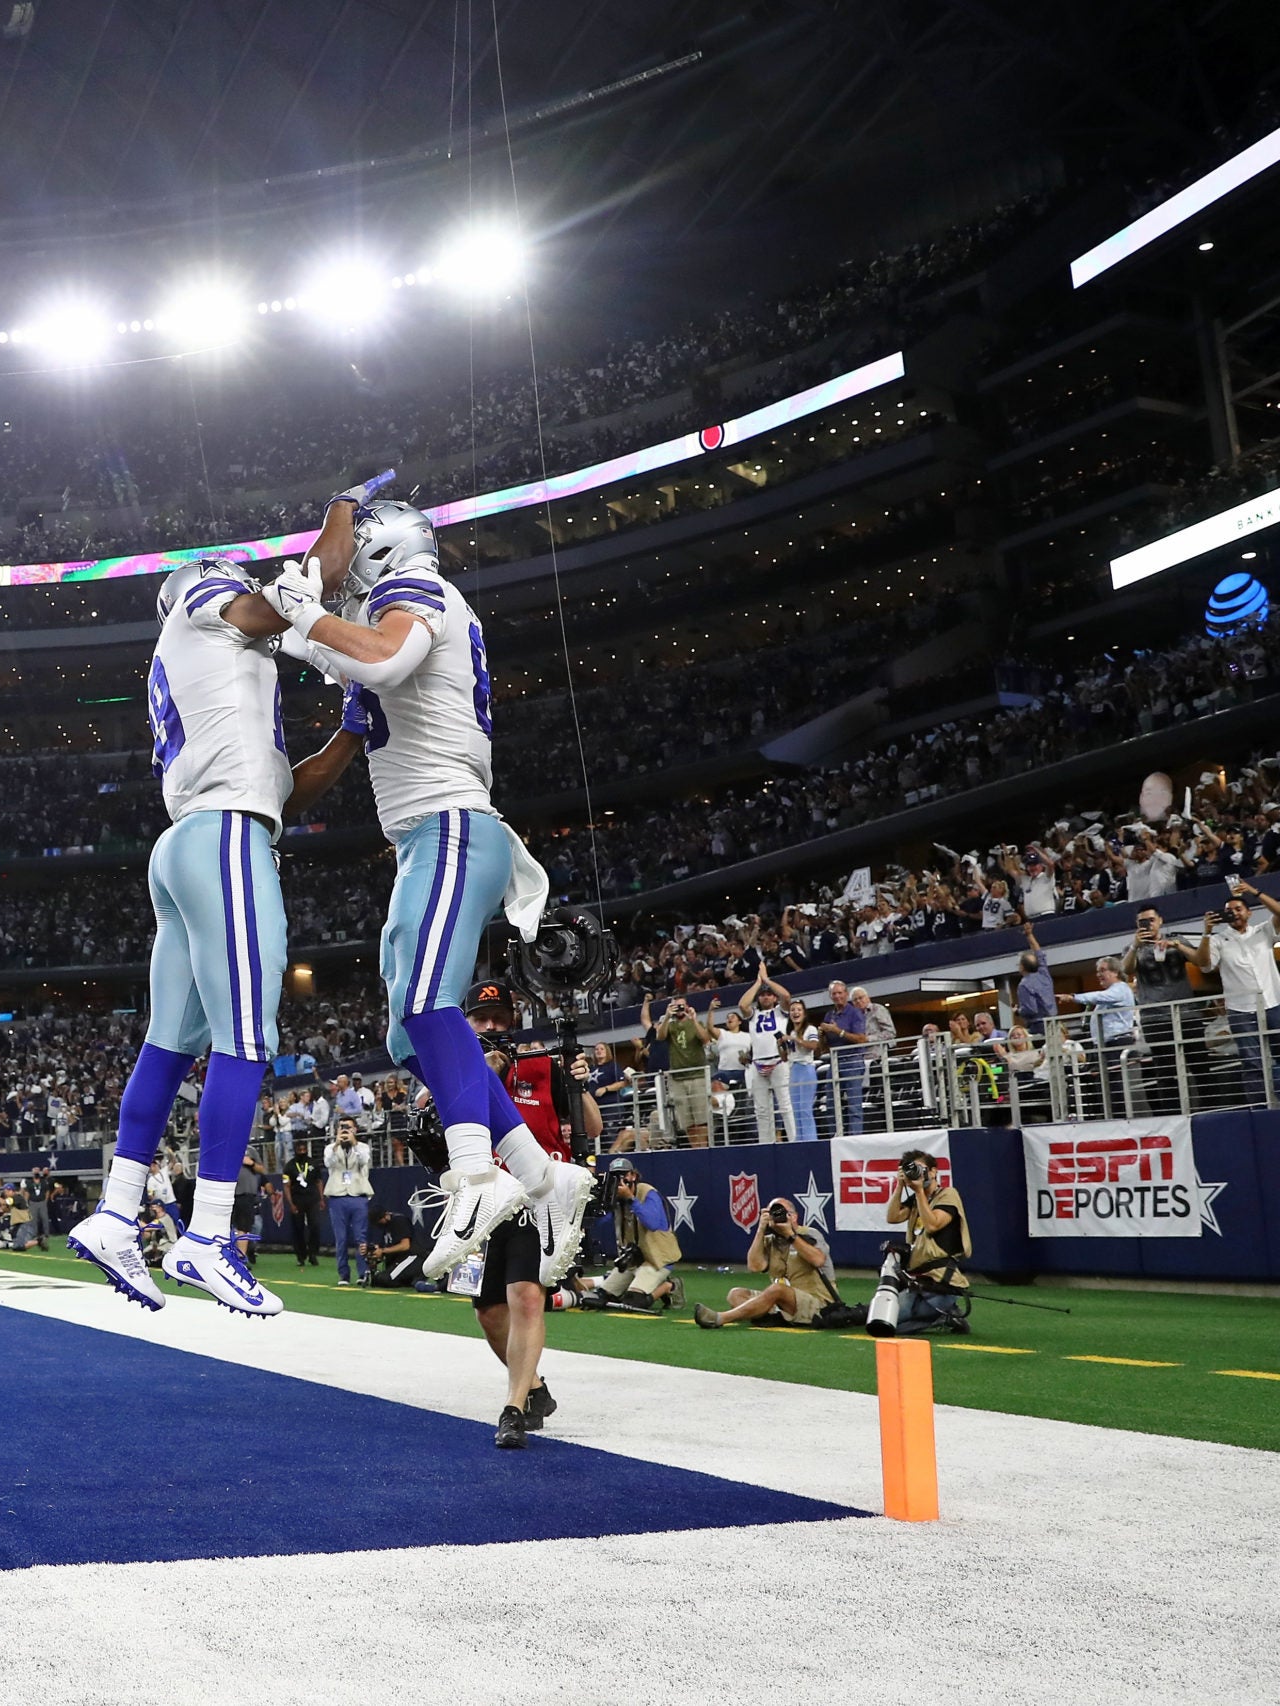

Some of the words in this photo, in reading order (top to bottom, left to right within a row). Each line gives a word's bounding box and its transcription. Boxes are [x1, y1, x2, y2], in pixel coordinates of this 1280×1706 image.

[677, 1030, 687, 1049] 4
[755, 1011, 777, 1034] 19
[1048, 1136, 1173, 1184] ESPN
[840, 1157, 951, 1204] ES
[1037, 1184, 1191, 1220] DEPORTES
